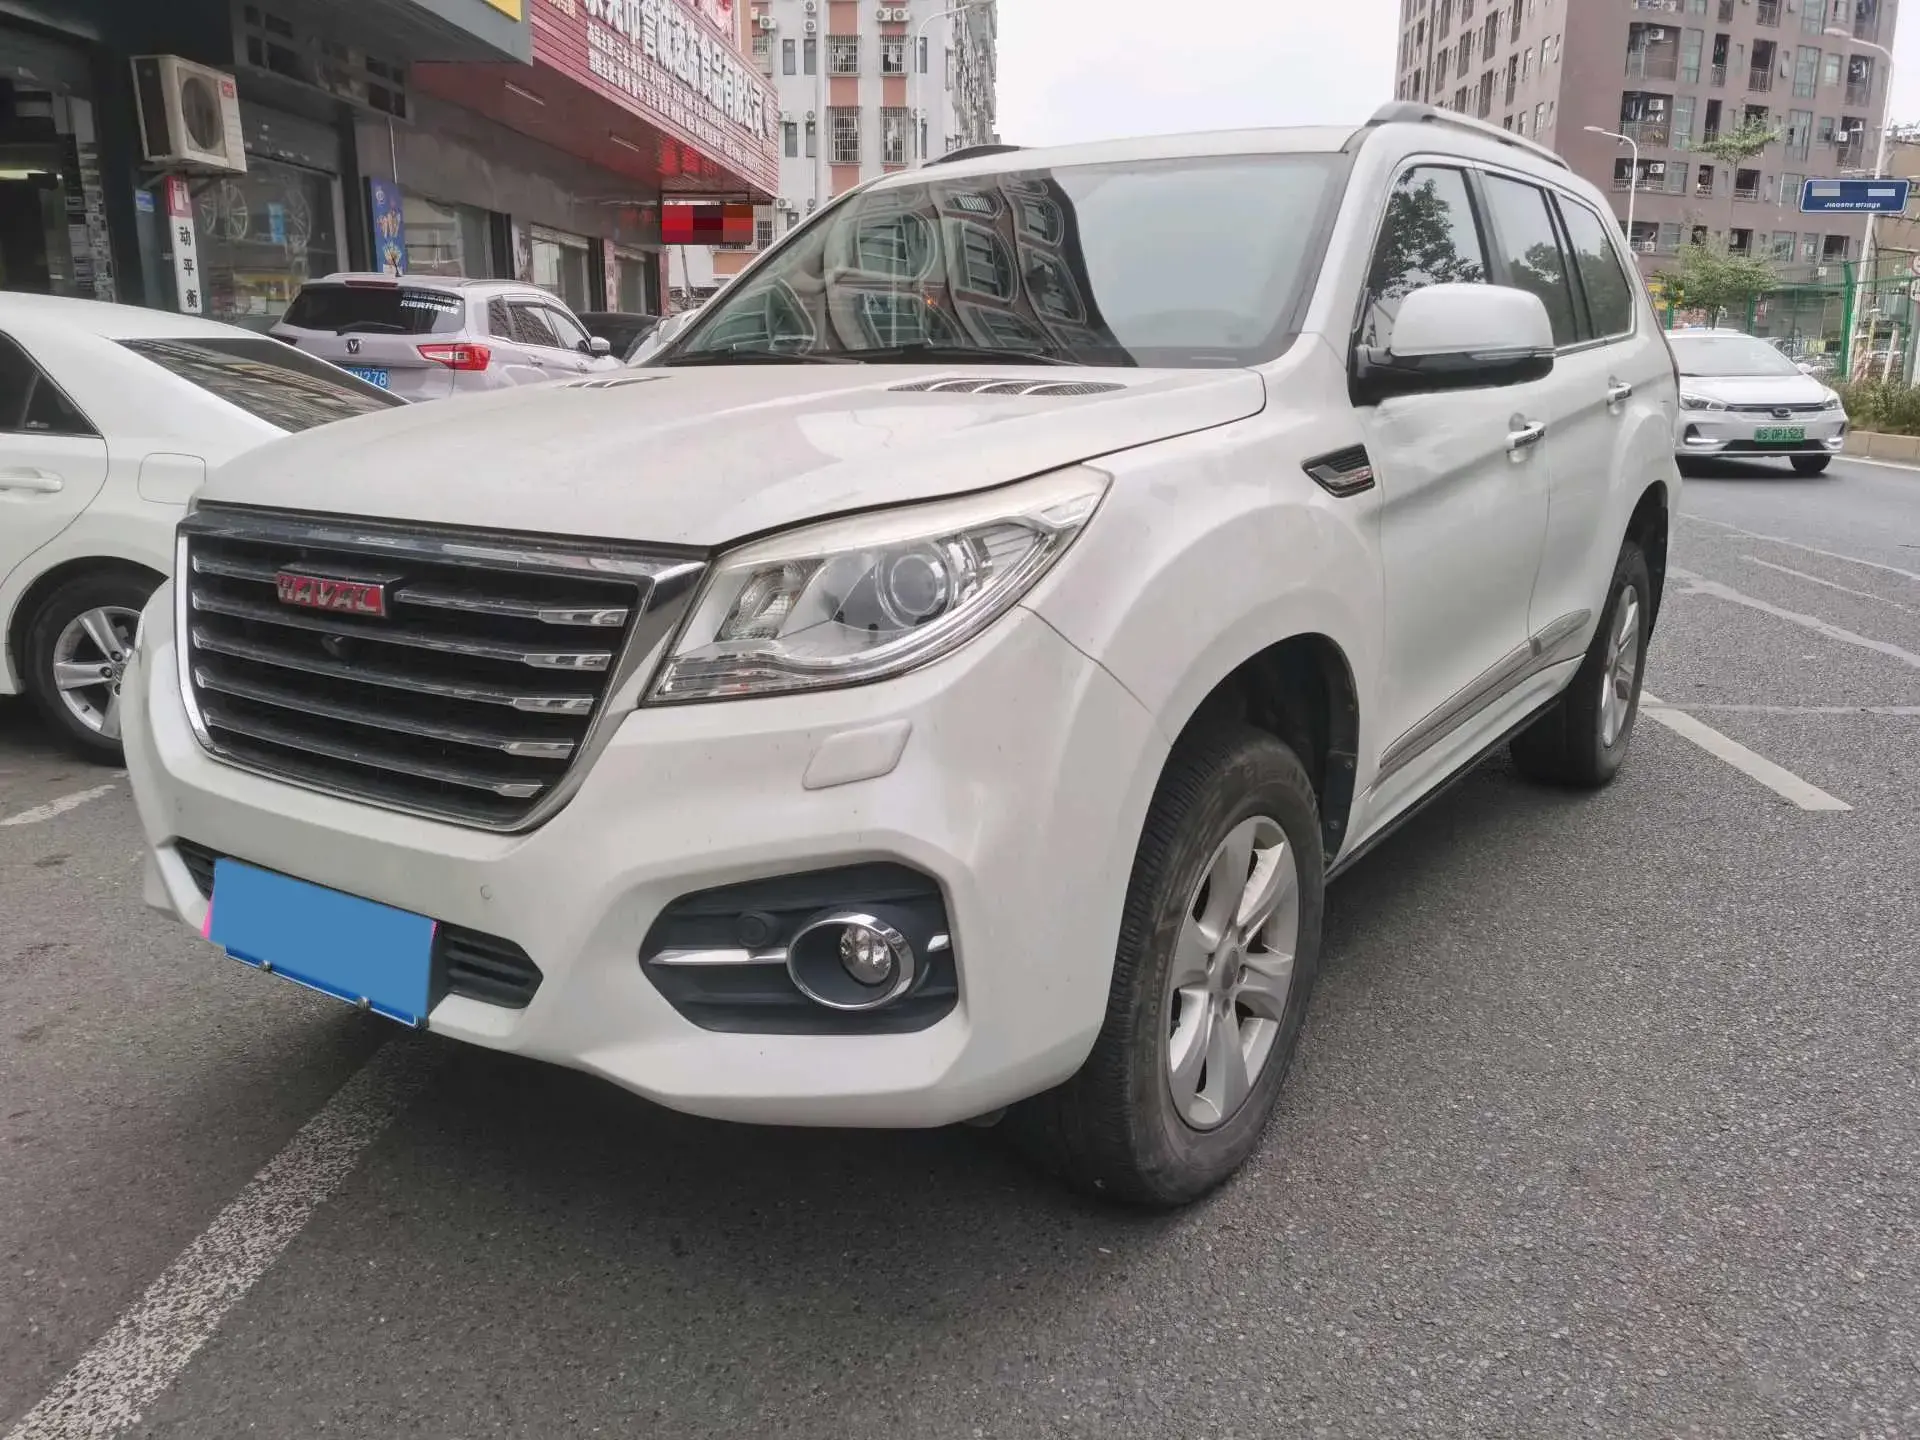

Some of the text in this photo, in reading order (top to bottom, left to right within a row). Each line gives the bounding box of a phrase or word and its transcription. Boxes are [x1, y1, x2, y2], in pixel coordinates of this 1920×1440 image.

[178, 225, 200, 309] 动平衡
[277, 574, 377, 613] HAVAL
